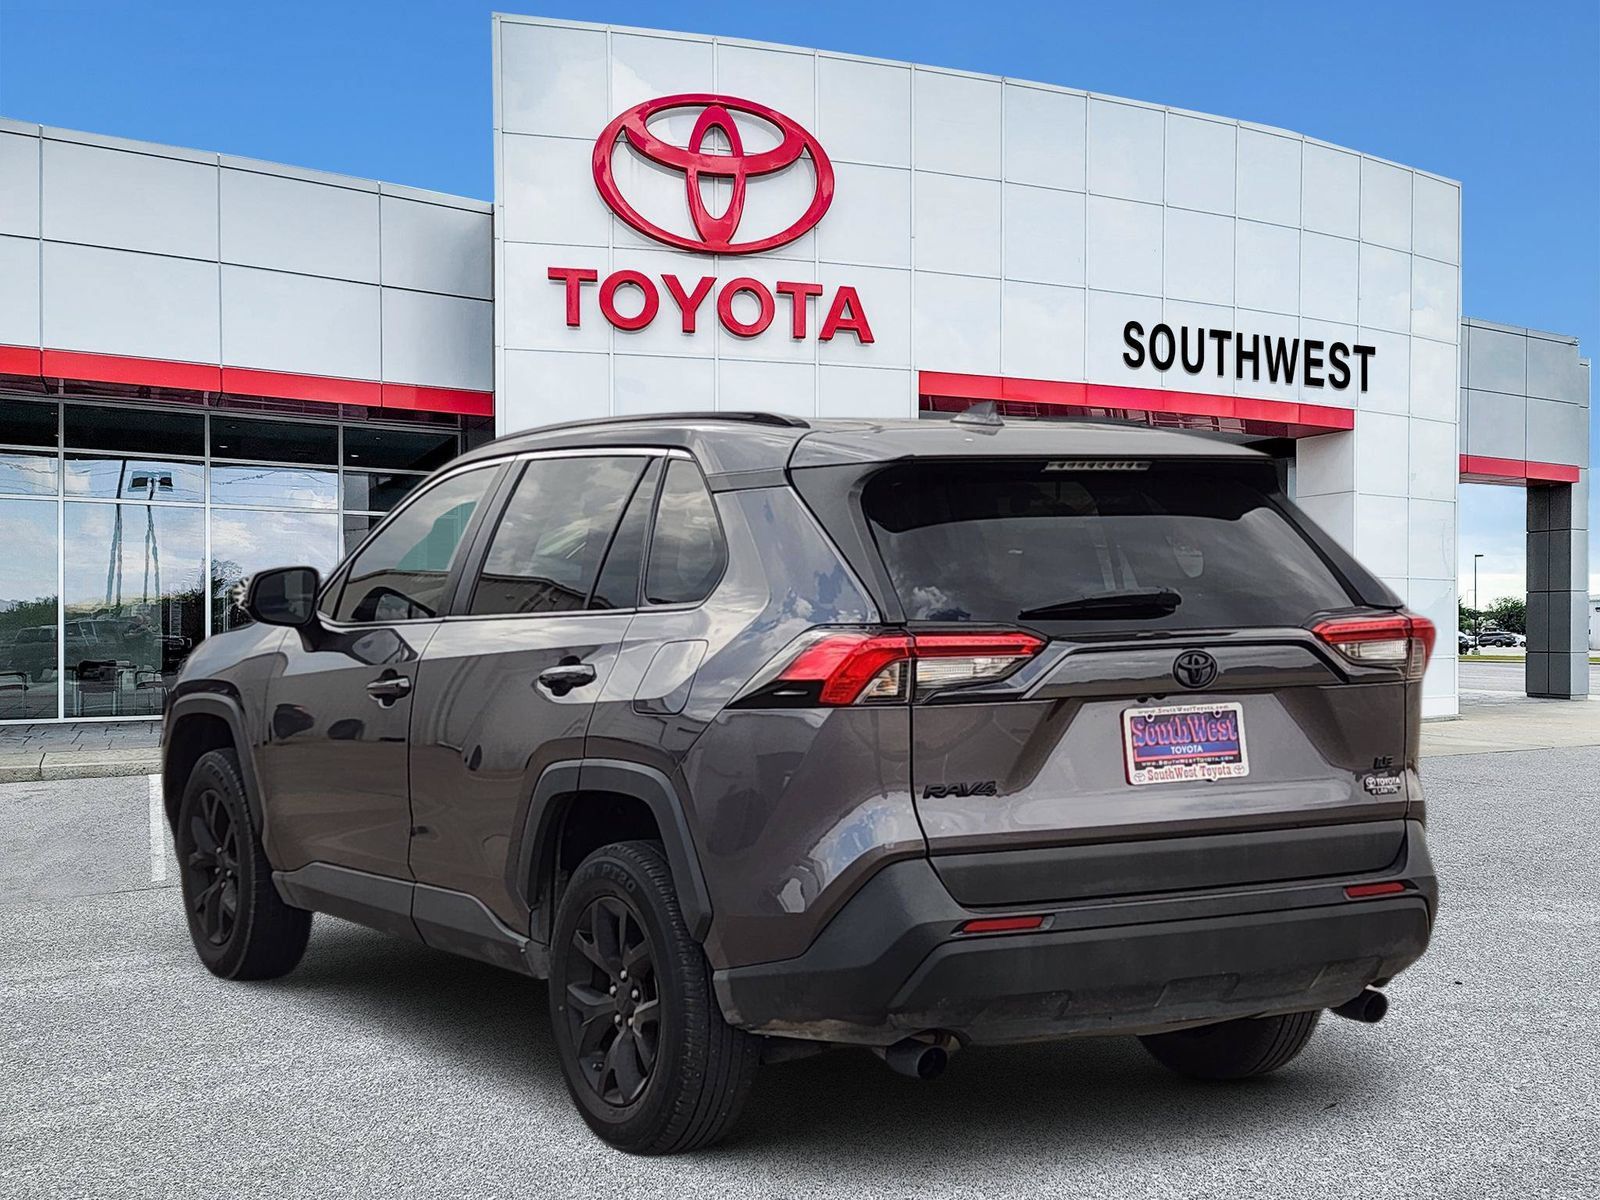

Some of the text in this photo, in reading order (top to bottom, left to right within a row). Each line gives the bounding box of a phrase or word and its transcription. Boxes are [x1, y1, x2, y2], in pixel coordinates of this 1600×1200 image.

[547, 266, 875, 344] TOYOTA
[1122, 320, 1376, 392] SOUTHWEST
[1170, 745, 1203, 755] TOYOTA
[1147, 763, 1232, 781] SouthWest Toyota
[1376, 776, 1400, 785] TOYOTA
[923, 781, 997, 799] RAV4
